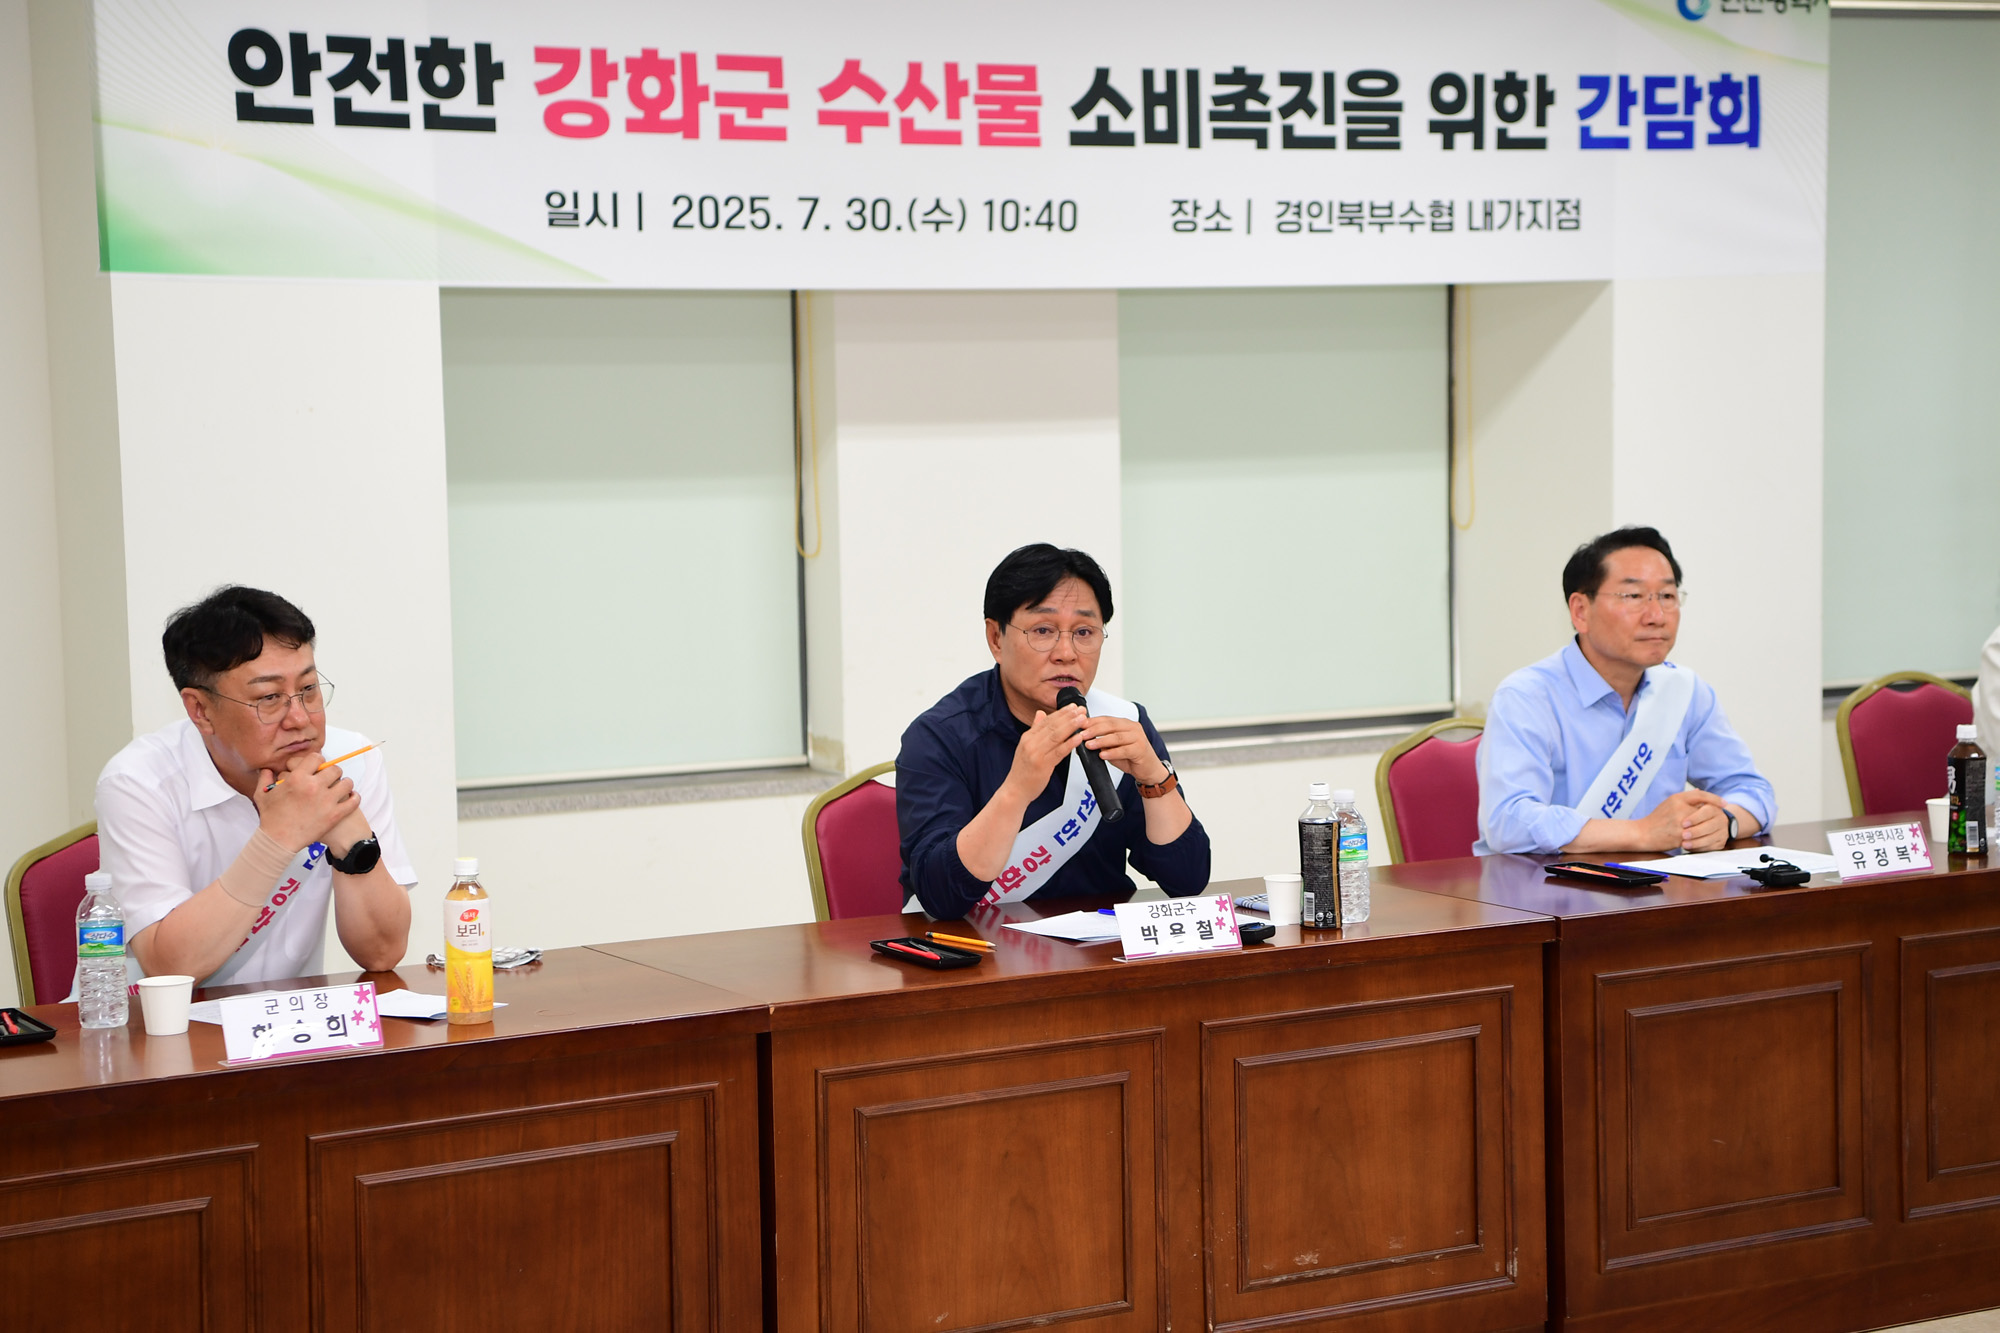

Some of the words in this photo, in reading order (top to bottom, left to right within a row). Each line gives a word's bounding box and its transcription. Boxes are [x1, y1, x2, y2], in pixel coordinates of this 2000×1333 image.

[228, 28, 504, 133] 안전한
[534, 46, 789, 142] 강화군
[817, 59, 1043, 148] 수산물
[1069, 66, 1404, 151] 소비촉진을
[1428, 70, 1556, 151] 위한
[1577, 73, 1761, 151] 간담회
[545, 190, 618, 229] 일시
[672, 194, 783, 231] 2025.
[797, 196, 830, 231] 7.
[846, 197, 967, 233] 30.(수)
[983, 199, 1078, 233] 10:40
[1171, 199, 1233, 233] 장소
[1275, 200, 1454, 234] 경인북부수협
[1468, 199, 1581, 232] 내가지점
[1601, 742, 1653, 819] 안전한
[1053, 780, 1098, 847] 전한
[1844, 827, 1905, 847] 인천광역시장
[1148, 901, 1197, 919] 강화군수
